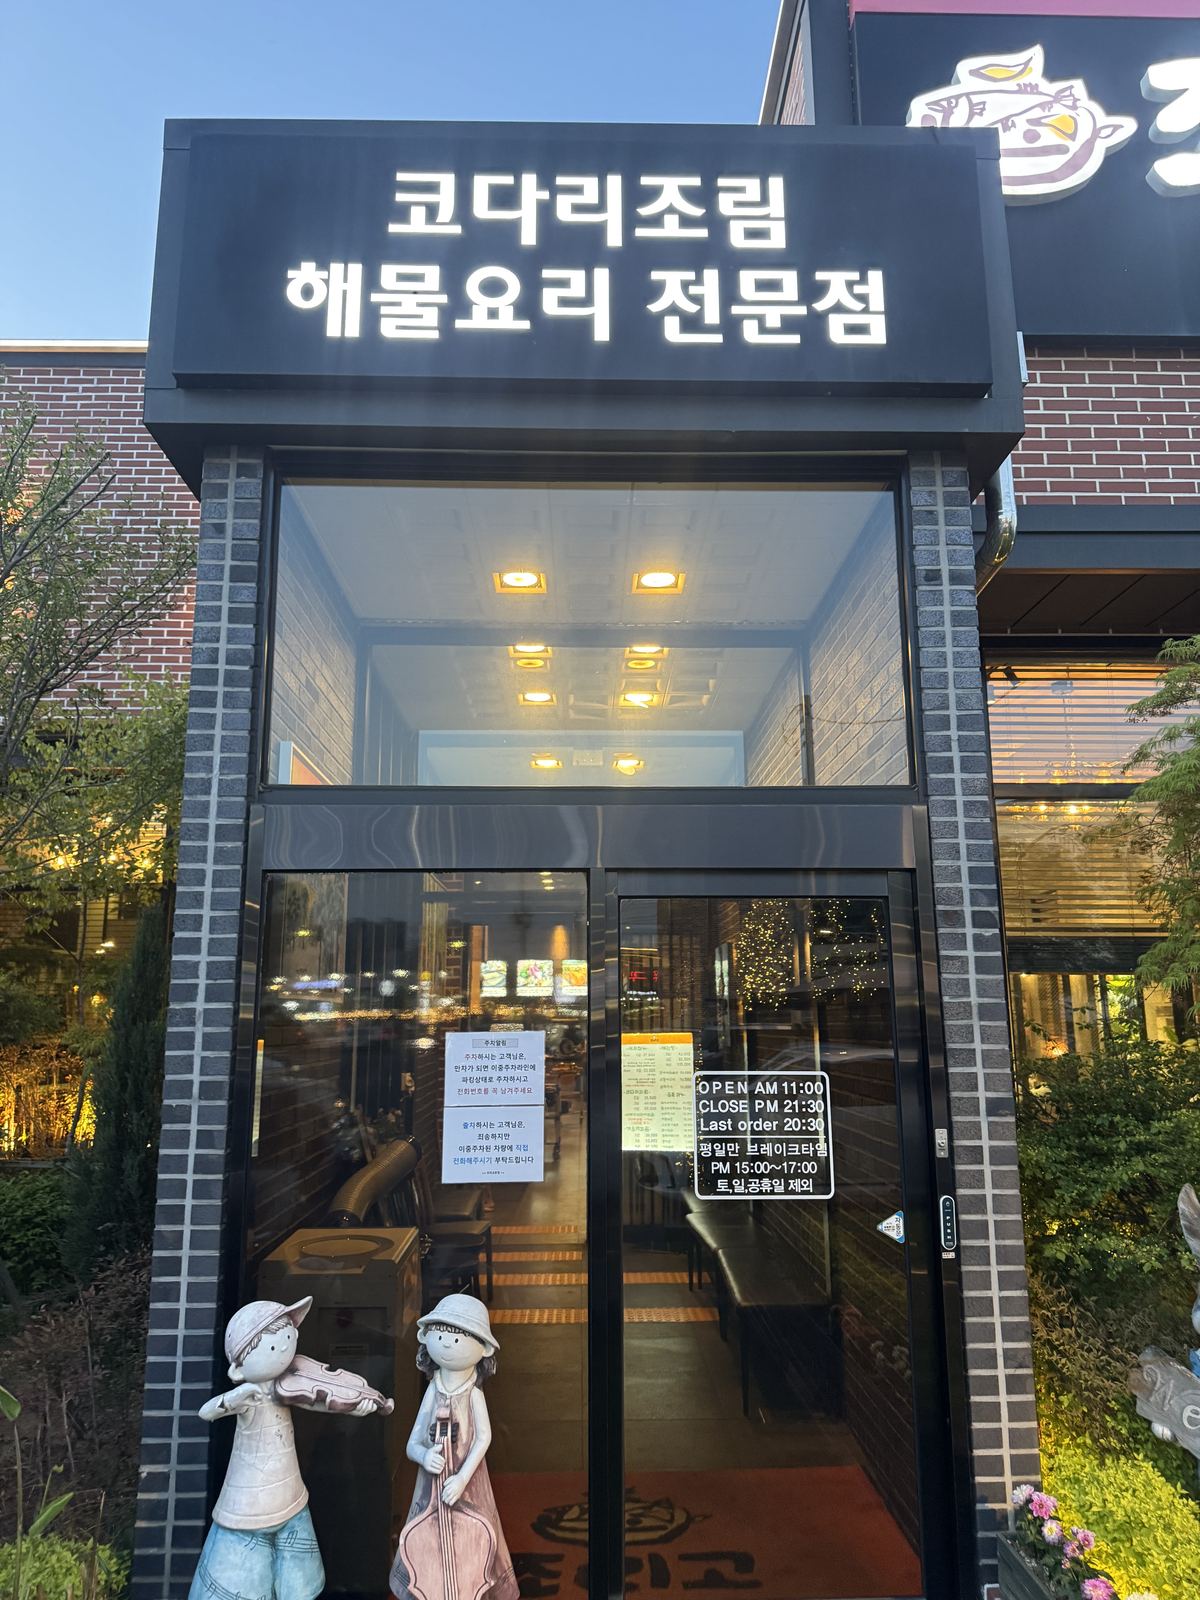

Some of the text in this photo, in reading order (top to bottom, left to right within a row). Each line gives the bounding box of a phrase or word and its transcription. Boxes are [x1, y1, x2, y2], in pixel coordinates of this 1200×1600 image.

[387, 171, 788, 249] 코다리조림
[286, 261, 887, 345] 해물요리 전문점
[484, 1039, 508, 1047] 주차알림
[464, 1053, 497, 1061] 주차하시는
[454, 1063, 537, 1073] 만차가 되면 이중주차라인에
[496, 1075, 529, 1083] 주차하시고
[457, 1087, 489, 1096] 전화번호를
[500, 1086, 533, 1095] 남겨주세요
[699, 1081, 748, 1095] OPEN
[754, 1081, 778, 1095] AM
[782, 1081, 824, 1095] 11:00
[699, 1099, 825, 1113] CLOSE PM 21:30
[463, 1121, 495, 1130] 출차하시는
[700, 1118, 825, 1131] Last order 20:30
[477, 1133, 511, 1141] 죄송하지만
[458, 1144, 529, 1153] 이중주차된 차량에 직접
[699, 1142, 828, 1157] 평일만 브레이크타임
[453, 1156, 534, 1165] 전화해주시기 부탁드립니다
[711, 1161, 818, 1174] PM 15:00~17:00
[716, 1178, 813, 1194] 토,일,공휴일 제외
